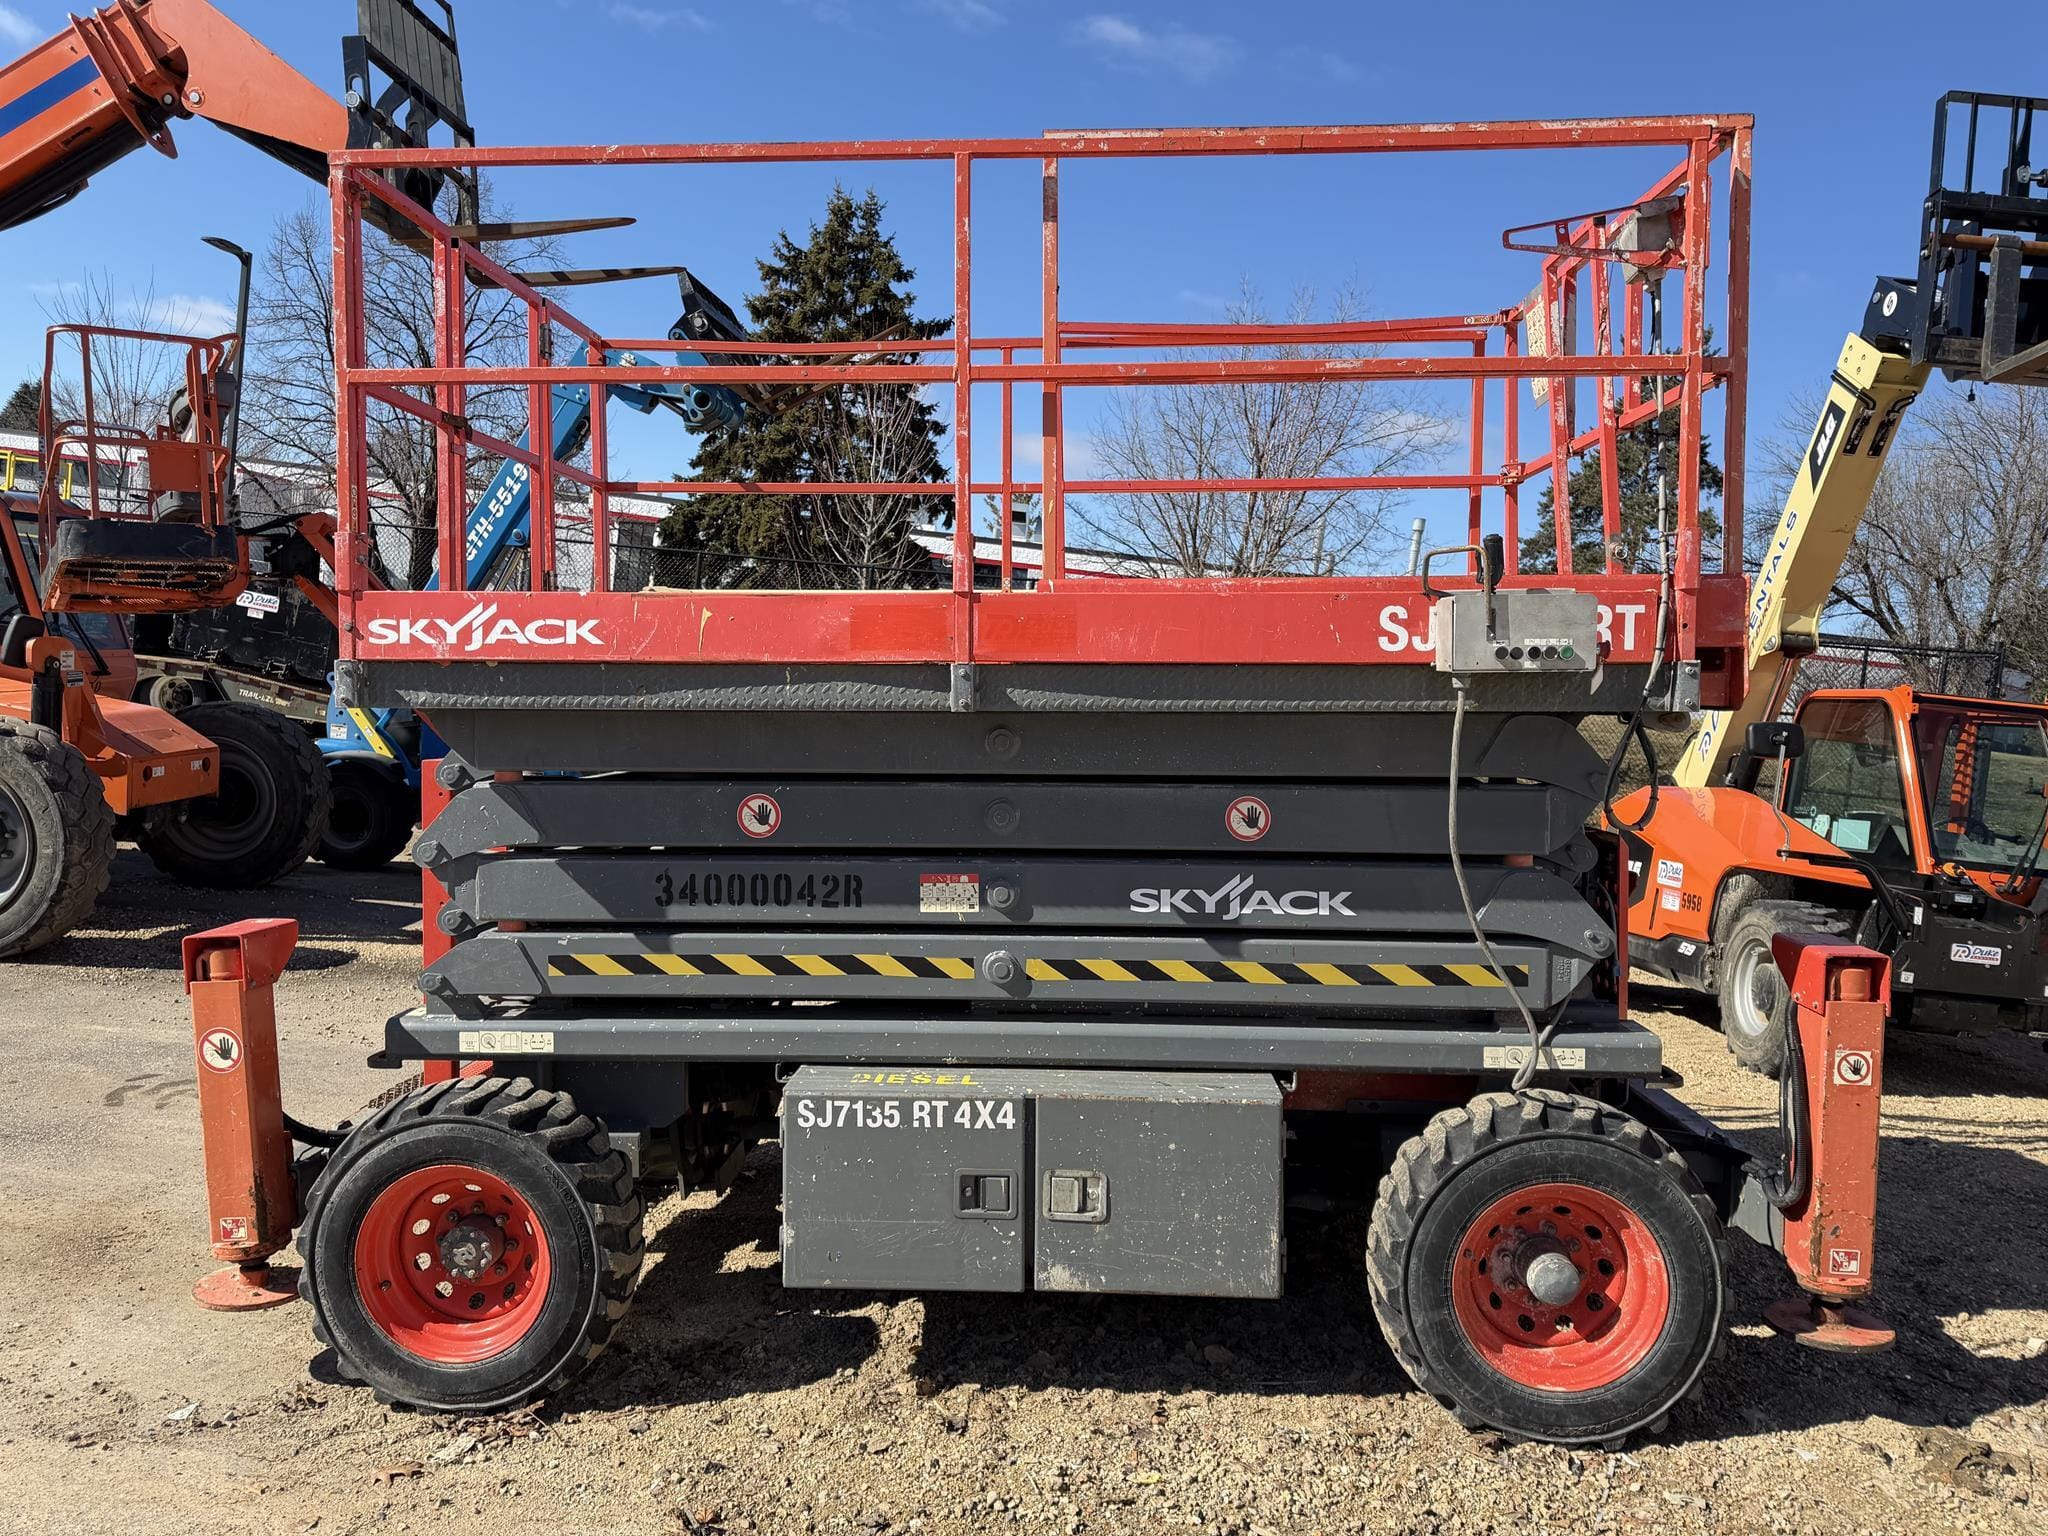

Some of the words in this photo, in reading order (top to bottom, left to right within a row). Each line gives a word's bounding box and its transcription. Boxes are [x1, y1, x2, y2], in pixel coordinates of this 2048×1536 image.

[1816, 412, 1837, 467] JLG
[466, 462, 529, 562] GTH-5519
[1748, 510, 1798, 636] ENTALS
[367, 601, 606, 652] SKYJACK
[654, 871, 864, 909] 34000042R
[1129, 873, 1358, 921] SKYJACK
[1682, 893, 1702, 912] 5958
[1972, 948, 1999, 957] Duke
[851, 1072, 980, 1086] DIESEL
[797, 1099, 900, 1129] SJ7135
[912, 1100, 949, 1129] RT
[953, 1100, 1016, 1130] 4X4
